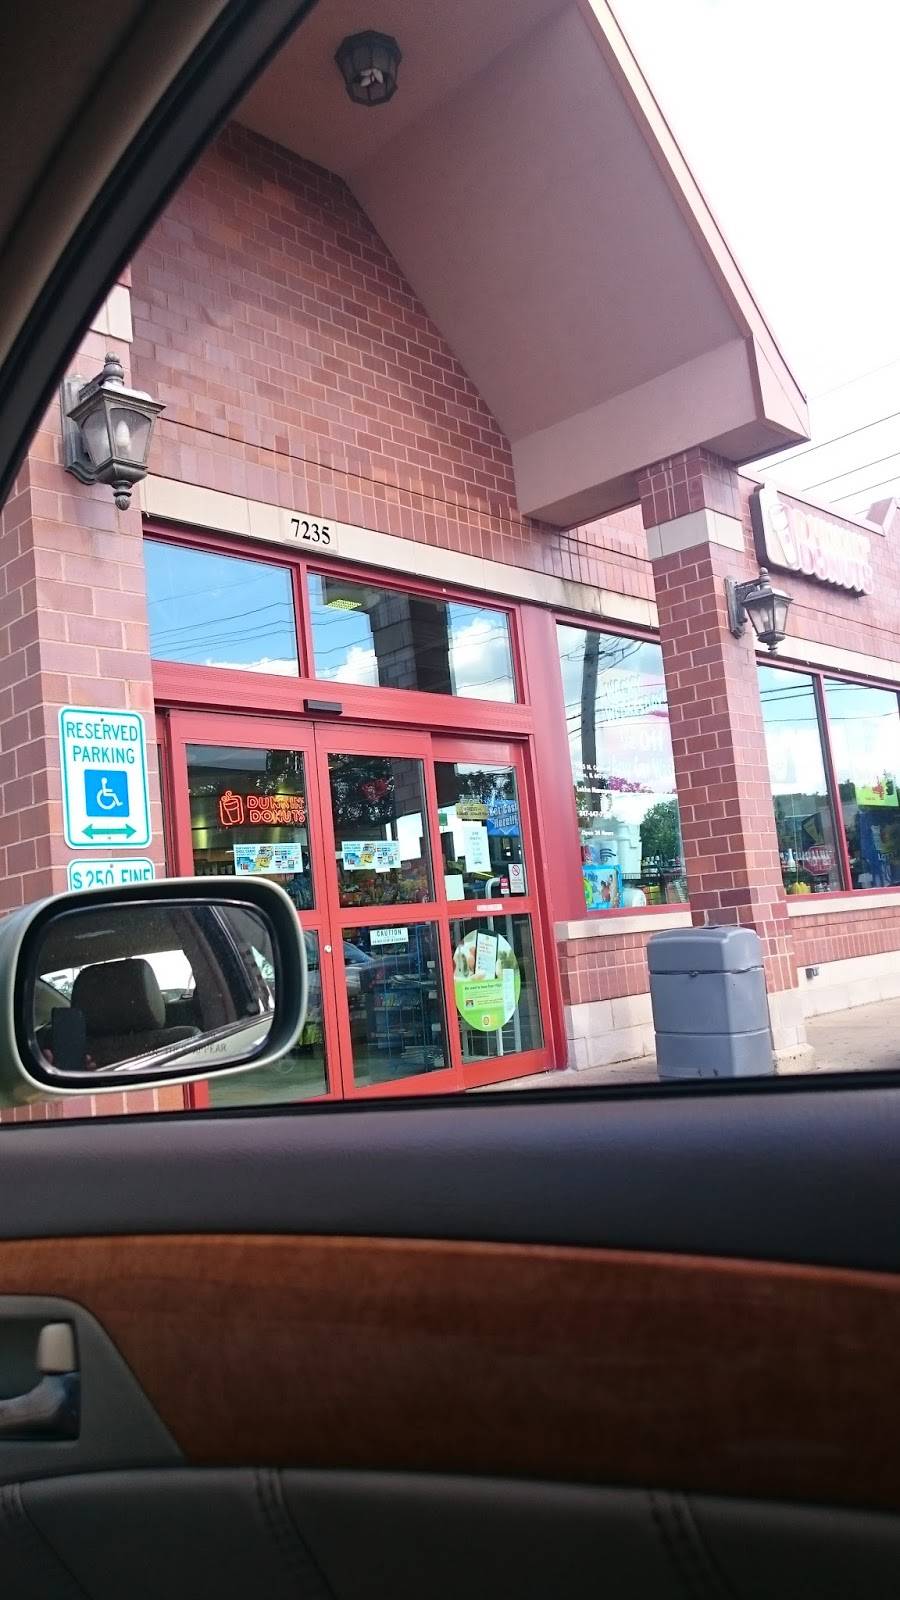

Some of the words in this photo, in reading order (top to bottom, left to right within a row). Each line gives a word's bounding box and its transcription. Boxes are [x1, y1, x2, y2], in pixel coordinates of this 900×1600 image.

[291, 518, 331, 545] 7235
[66, 721, 138, 742] RESERVED
[73, 745, 135, 764] PARKING
[250, 809, 306, 823] DONUTS
[121, 868, 151, 883] FINE
[376, 929, 402, 937] CAUTION
